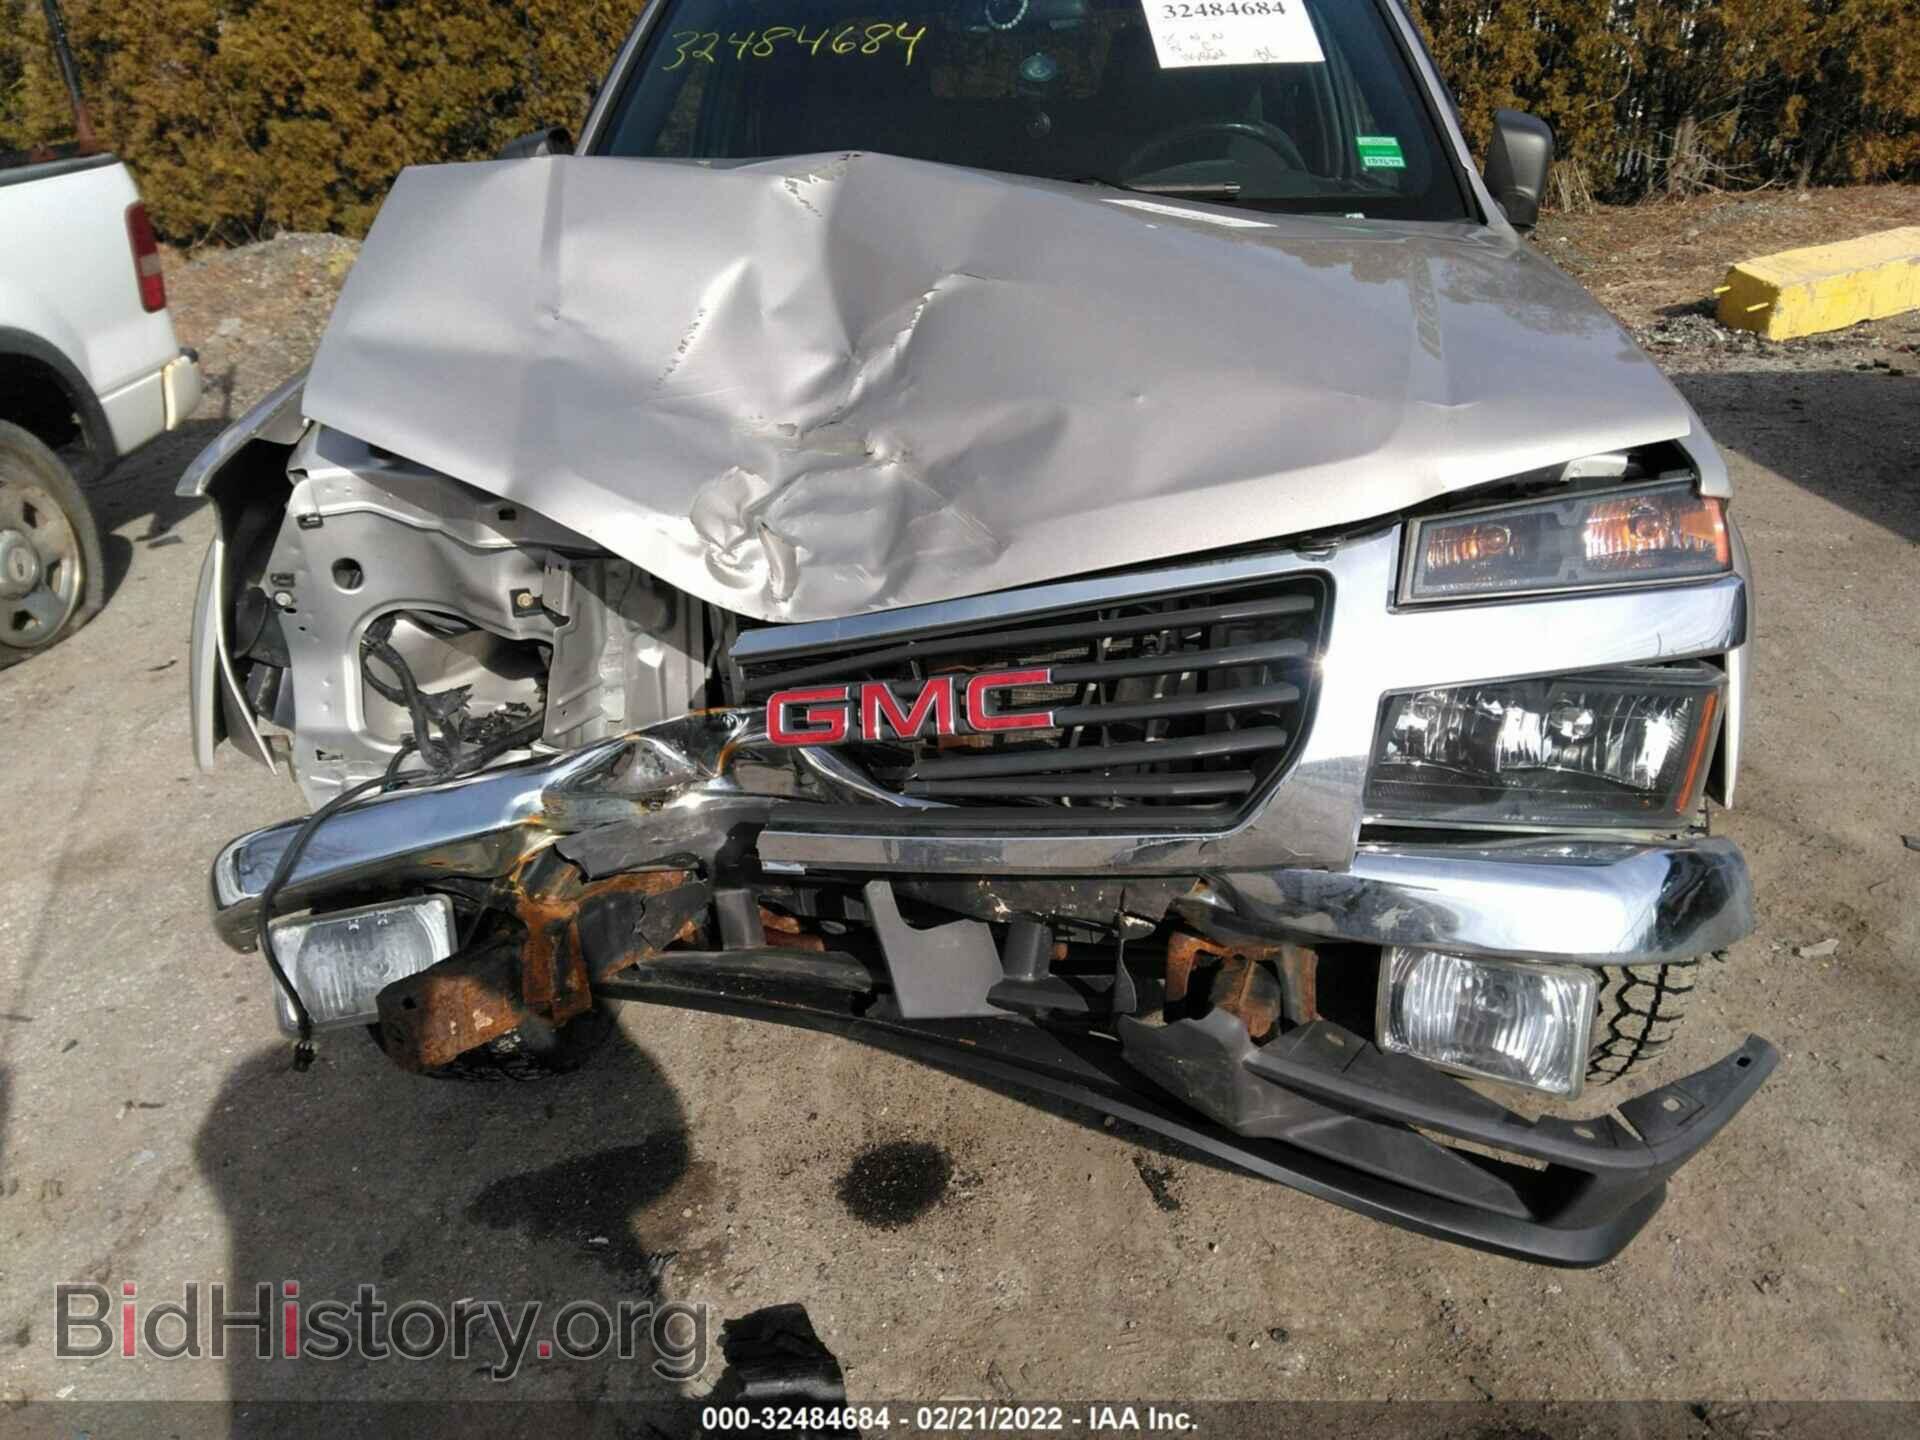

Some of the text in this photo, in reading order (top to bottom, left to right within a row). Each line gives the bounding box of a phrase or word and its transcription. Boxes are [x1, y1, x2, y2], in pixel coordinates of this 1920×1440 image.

[1163, 1, 1287, 19] 32484684
[662, 22, 926, 70] 32484684
[766, 667, 1055, 746] GMC
